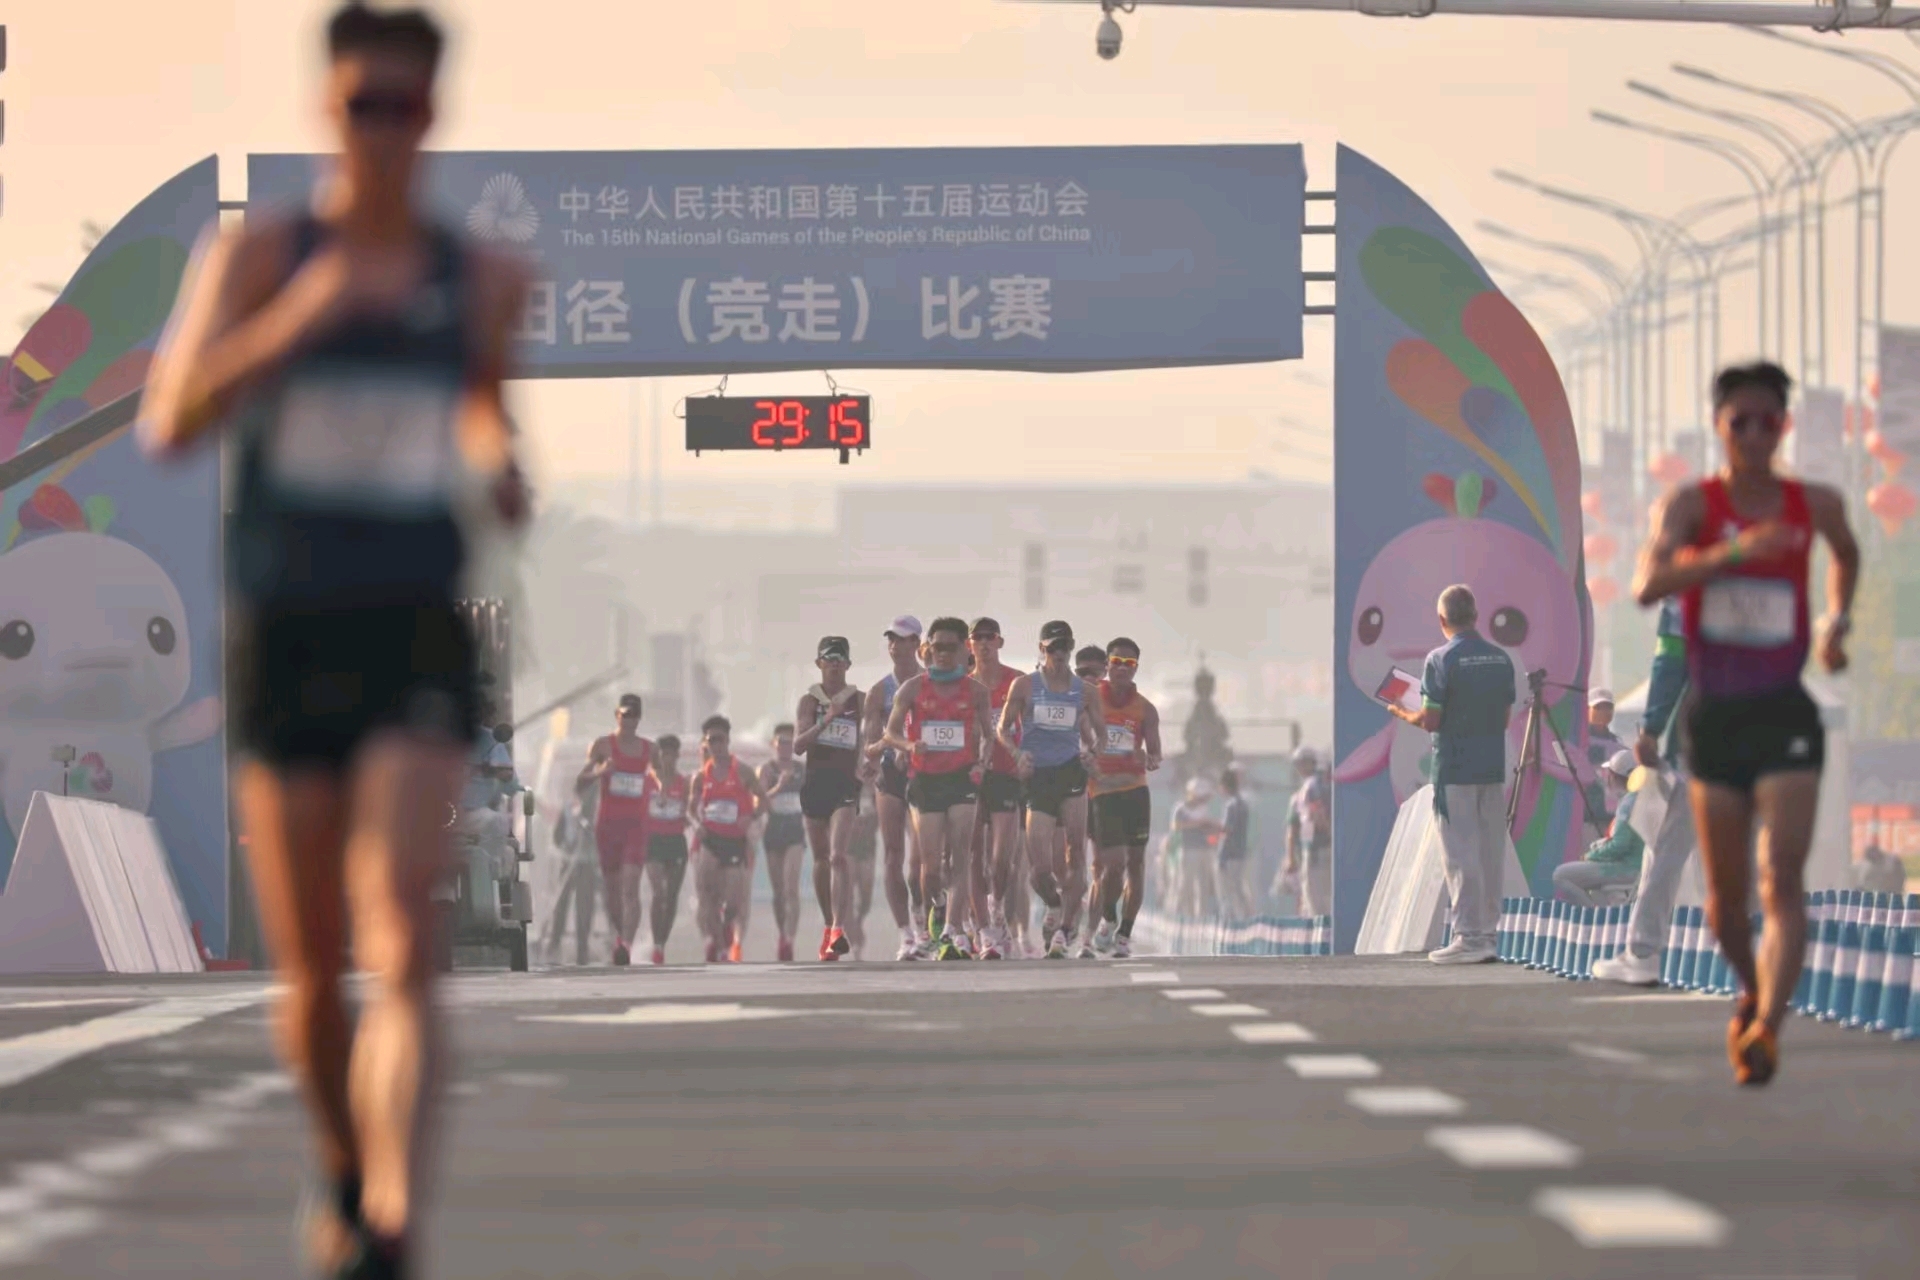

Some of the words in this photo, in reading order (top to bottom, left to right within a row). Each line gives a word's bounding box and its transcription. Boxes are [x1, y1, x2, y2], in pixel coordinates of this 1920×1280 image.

[559, 181, 1089, 221] 中华人民共和国第十五届运动会
[560, 229, 595, 246] The
[601, 228, 640, 246] 15th
[646, 227, 721, 245] National
[726, 228, 789, 245] Games
[794, 226, 813, 244] of
[818, 226, 847, 243] the
[853, 226, 927, 247] People's
[932, 225, 1010, 247] Republic
[1016, 225, 1034, 242] of
[1039, 224, 1090, 242] China
[752, 400, 863, 446] 29:15
[1047, 706, 1065, 720] 128
[933, 727, 954, 740] 150
